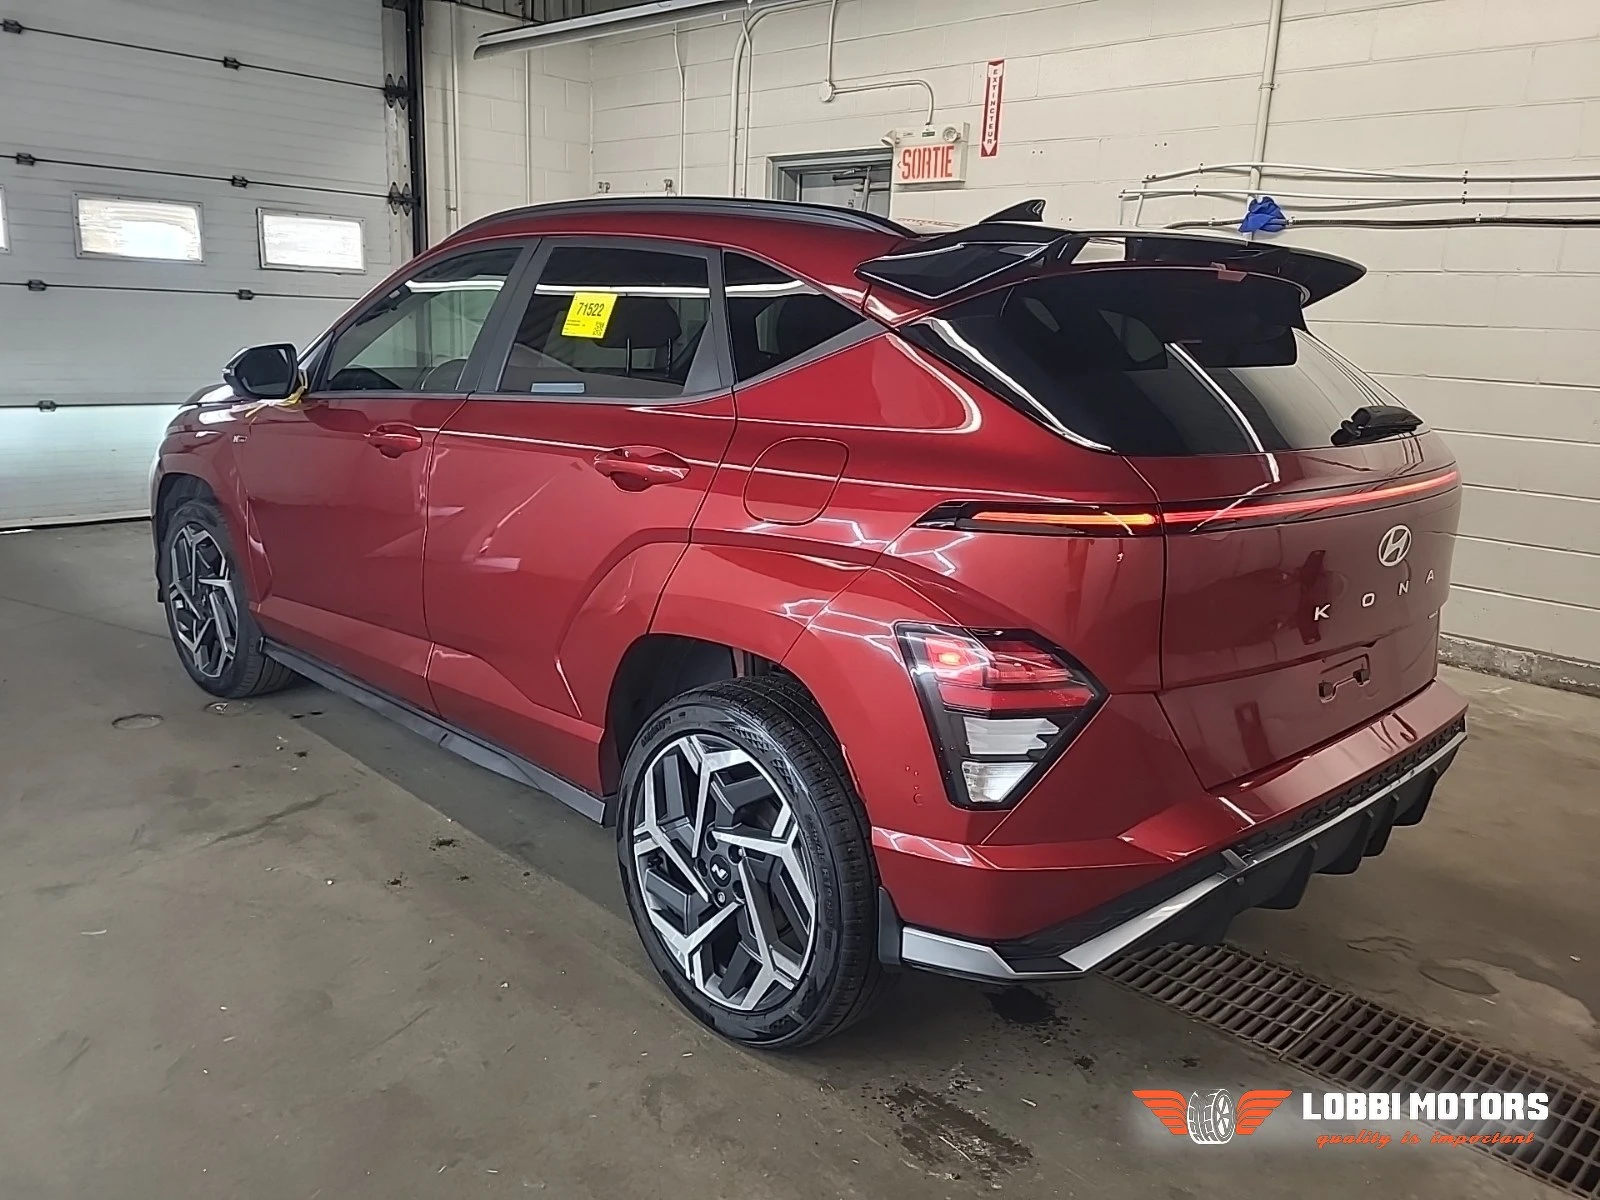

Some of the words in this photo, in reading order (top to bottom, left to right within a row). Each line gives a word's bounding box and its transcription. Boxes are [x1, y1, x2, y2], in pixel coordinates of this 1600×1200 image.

[987, 68, 999, 145] EXTINCTEUR
[902, 146, 954, 180] SORTIE
[576, 302, 605, 317] 71522
